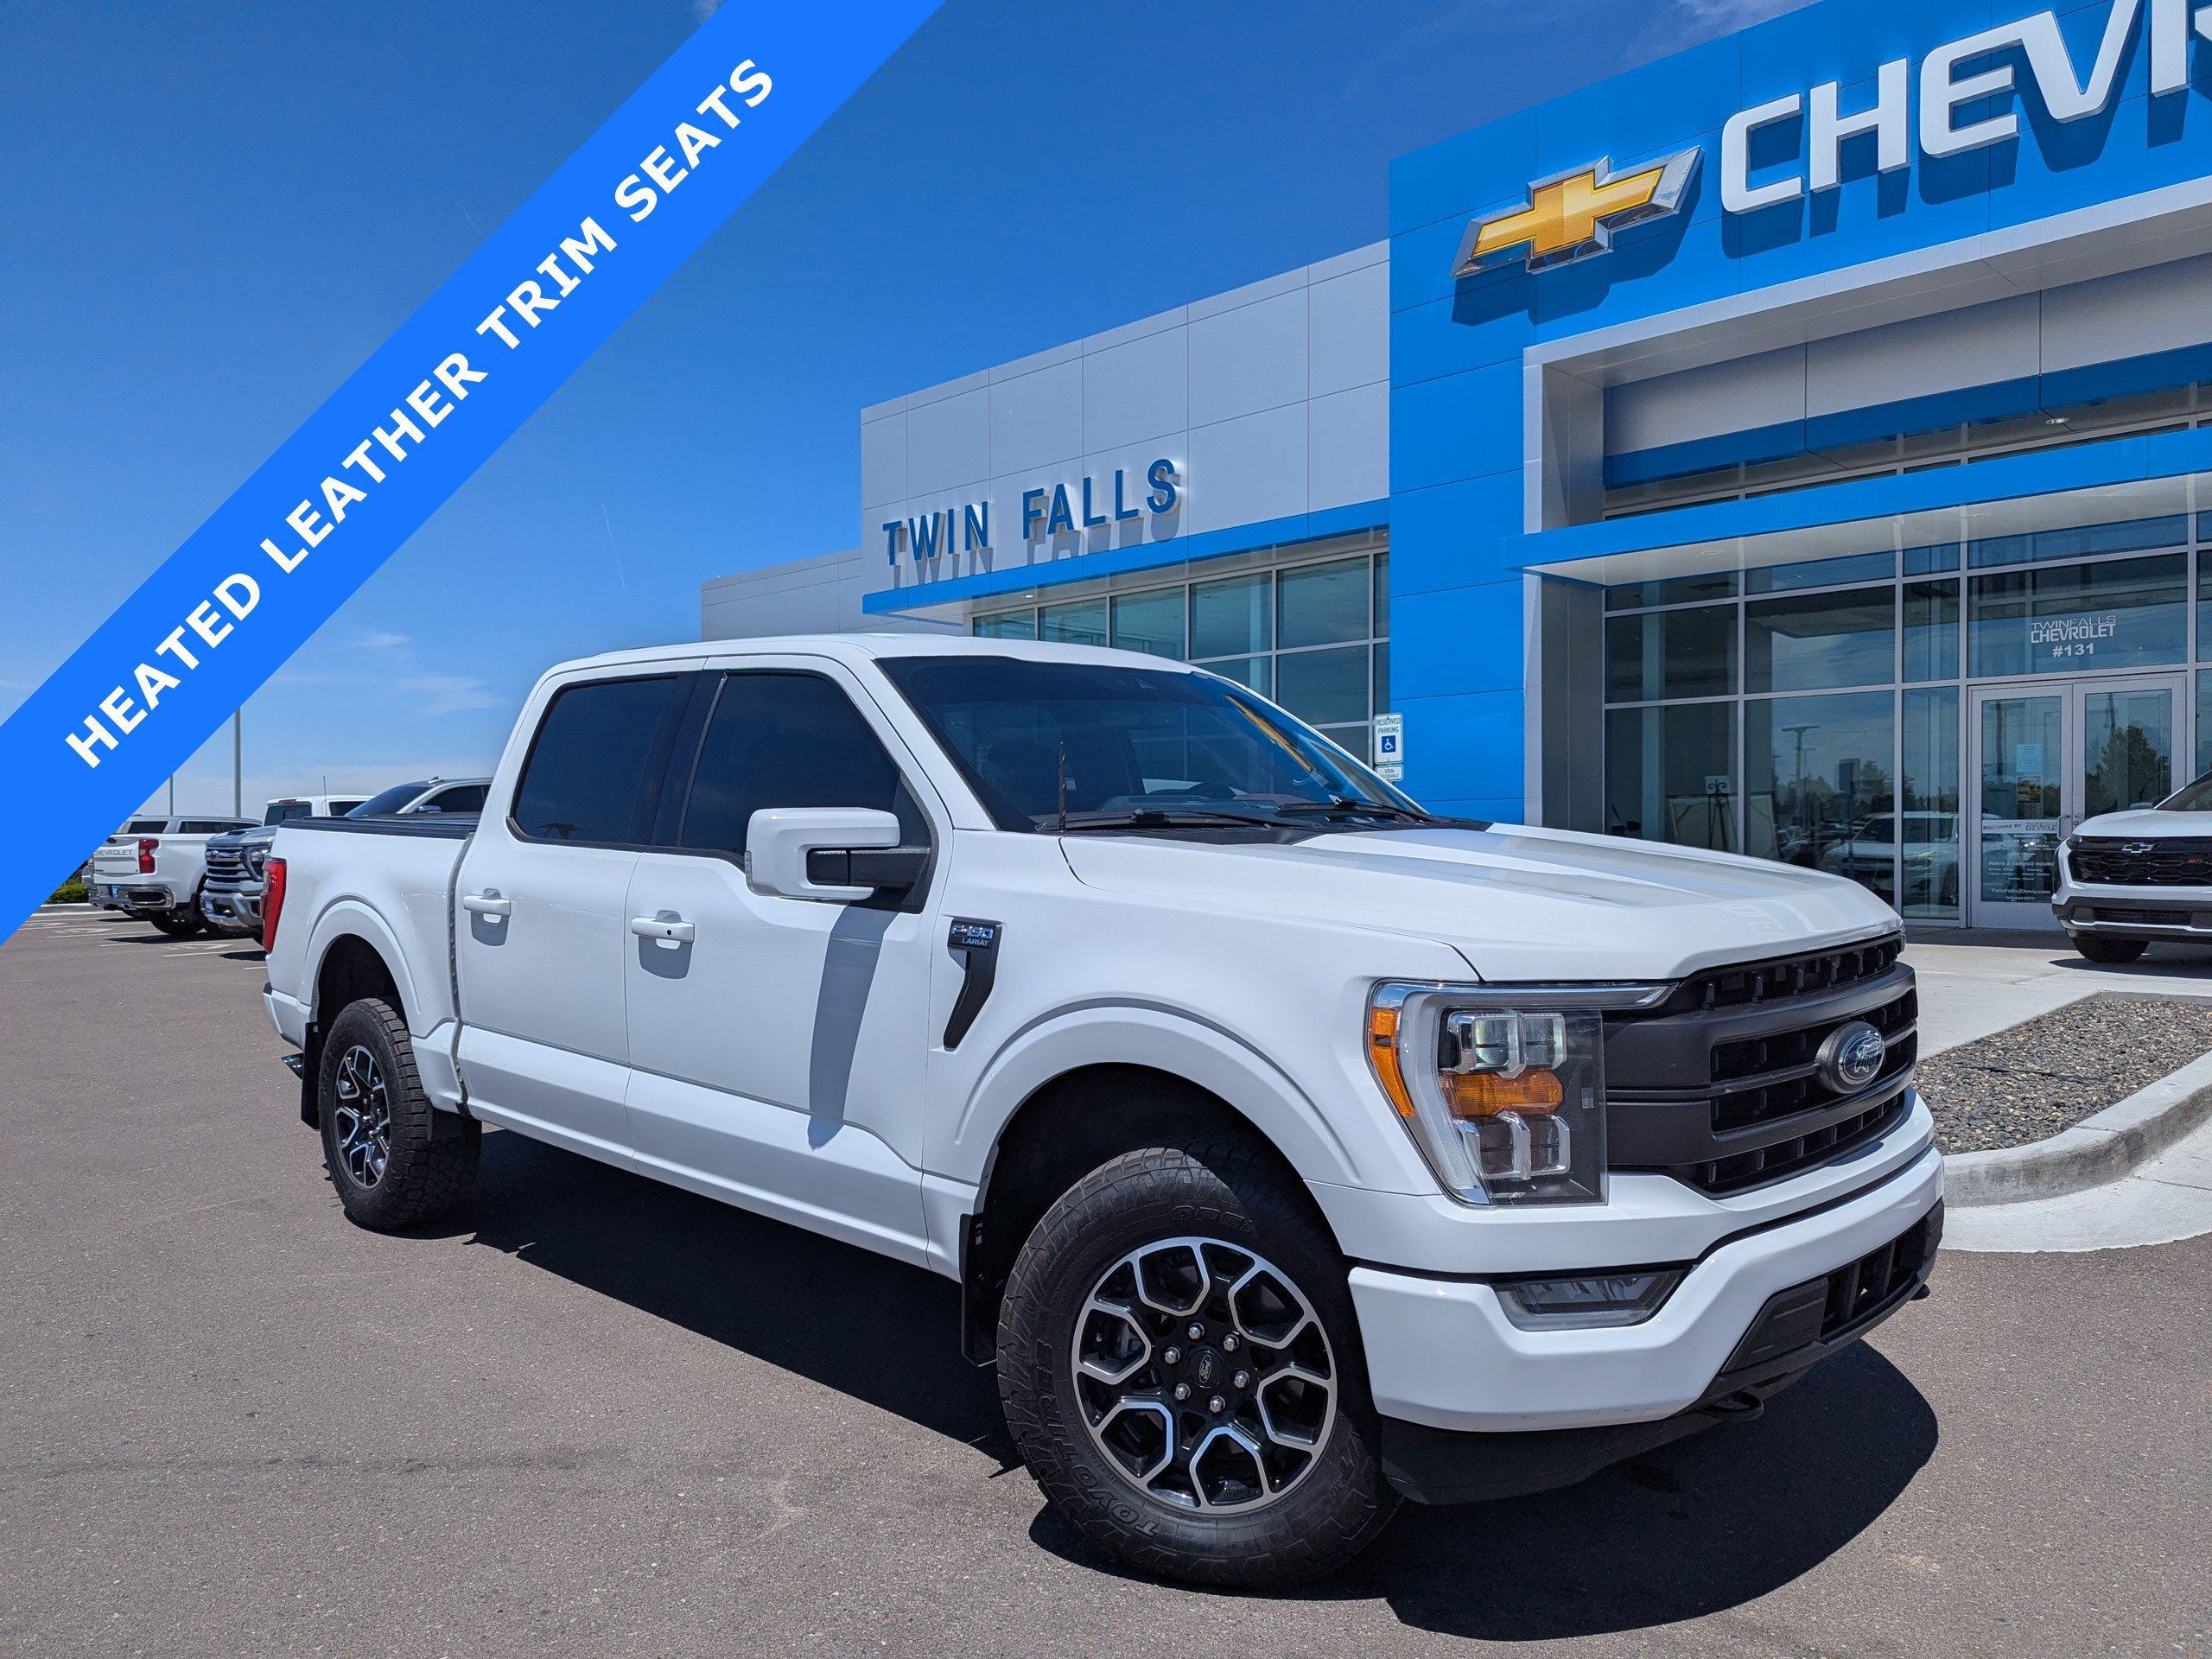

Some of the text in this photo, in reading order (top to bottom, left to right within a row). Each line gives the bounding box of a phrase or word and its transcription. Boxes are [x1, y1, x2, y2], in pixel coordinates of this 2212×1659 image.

[882, 459, 1181, 566] TWIN FALLS
[2031, 623, 2117, 644] CHEVROLET
[2052, 643, 2094, 658] #131
[951, 924, 994, 939] F-150
[962, 938, 989, 946] LARIAT
[1071, 1463, 1160, 1539] TOYO
